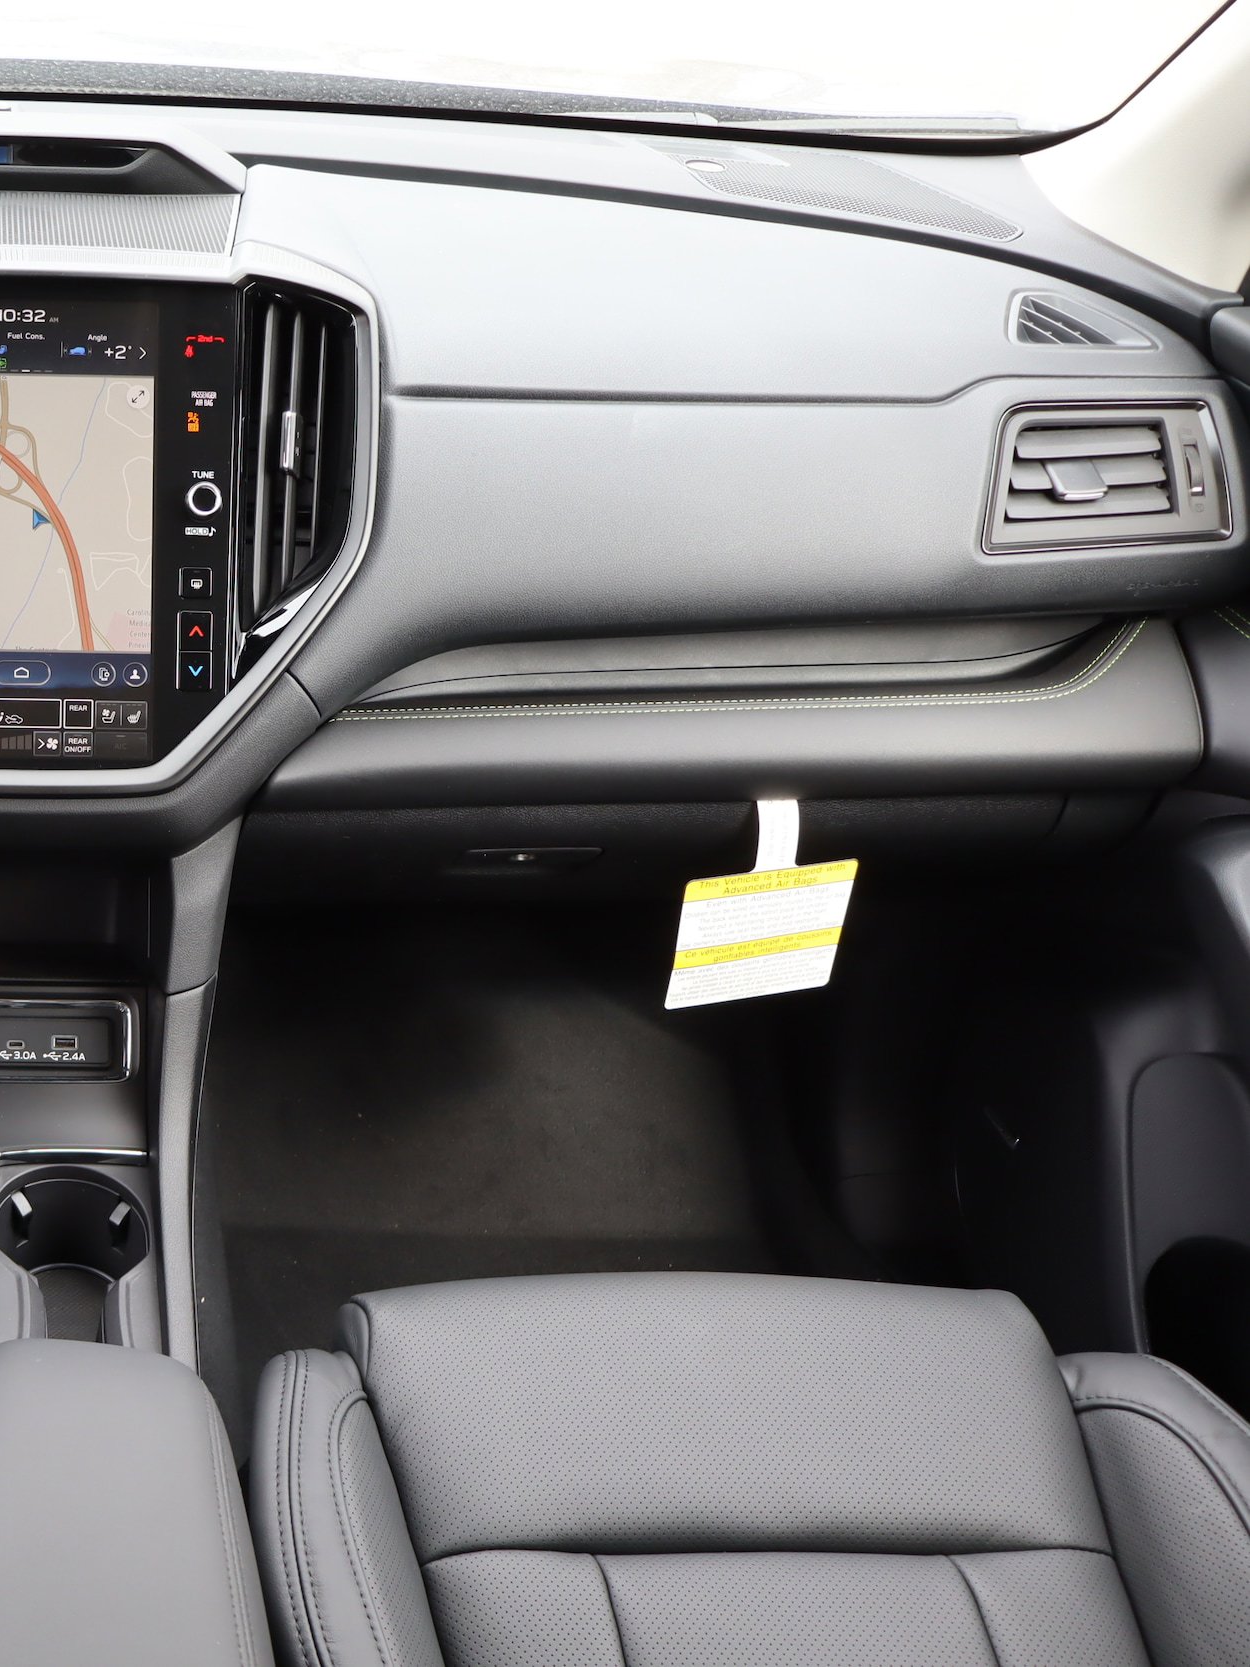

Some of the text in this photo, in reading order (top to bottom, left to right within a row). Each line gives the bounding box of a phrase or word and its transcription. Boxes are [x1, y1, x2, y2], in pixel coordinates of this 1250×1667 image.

[7, 332, 46, 340] Fuel Cons.
[87, 334, 108, 343] Angle
[197, 335, 214, 343] 2nd
[191, 391, 217, 399] PASSENGER
[204, 399, 214, 407] BAG
[192, 470, 215, 479] TUNE
[185, 527, 209, 536] HOLD
[69, 704, 88, 712] REAR
[699, 863, 846, 889] This Vehicle is Equipped with
[722, 877, 819, 895] Advanced Air Bags
[13, 1051, 37, 1060] 3.0A
[62, 1051, 86, 1061] 2.4A
